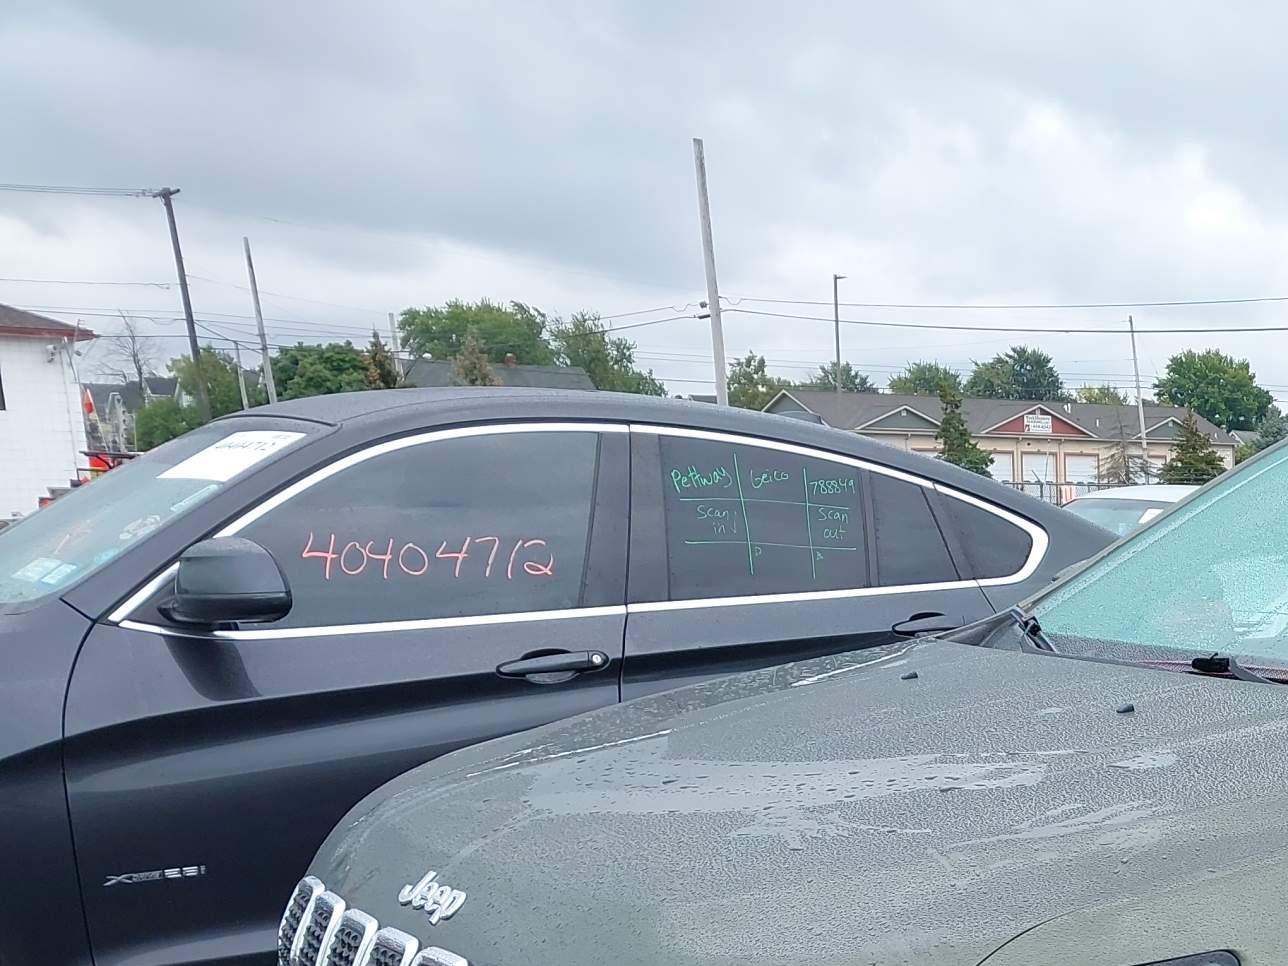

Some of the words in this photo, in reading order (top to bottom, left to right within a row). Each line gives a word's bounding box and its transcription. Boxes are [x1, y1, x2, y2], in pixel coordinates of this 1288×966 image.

[671, 464, 733, 494] Pettway
[809, 478, 856, 496] 788849
[301, 531, 555, 580] 40404712
[398, 870, 467, 925] Jeep
